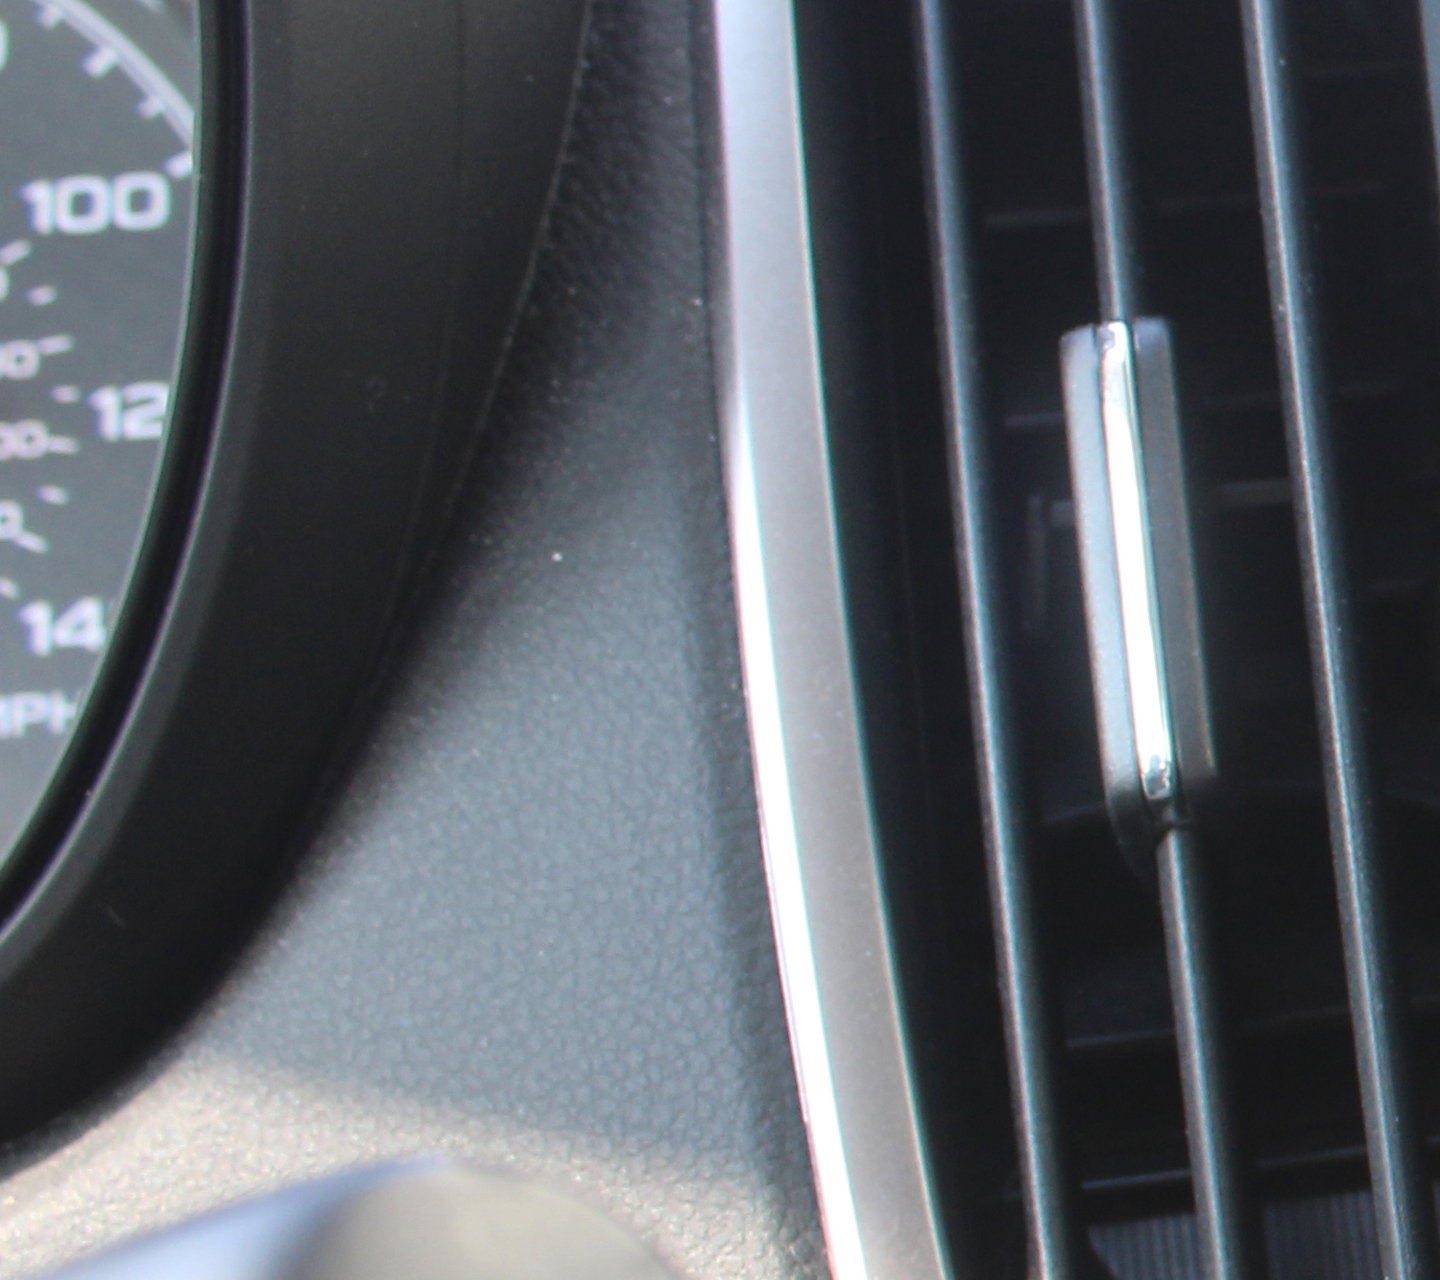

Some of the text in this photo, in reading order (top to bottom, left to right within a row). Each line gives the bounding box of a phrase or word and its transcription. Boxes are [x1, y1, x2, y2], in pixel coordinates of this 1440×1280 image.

[20, 172, 171, 235] 100
[89, 380, 170, 442] 12
[18, 597, 108, 657] 14
